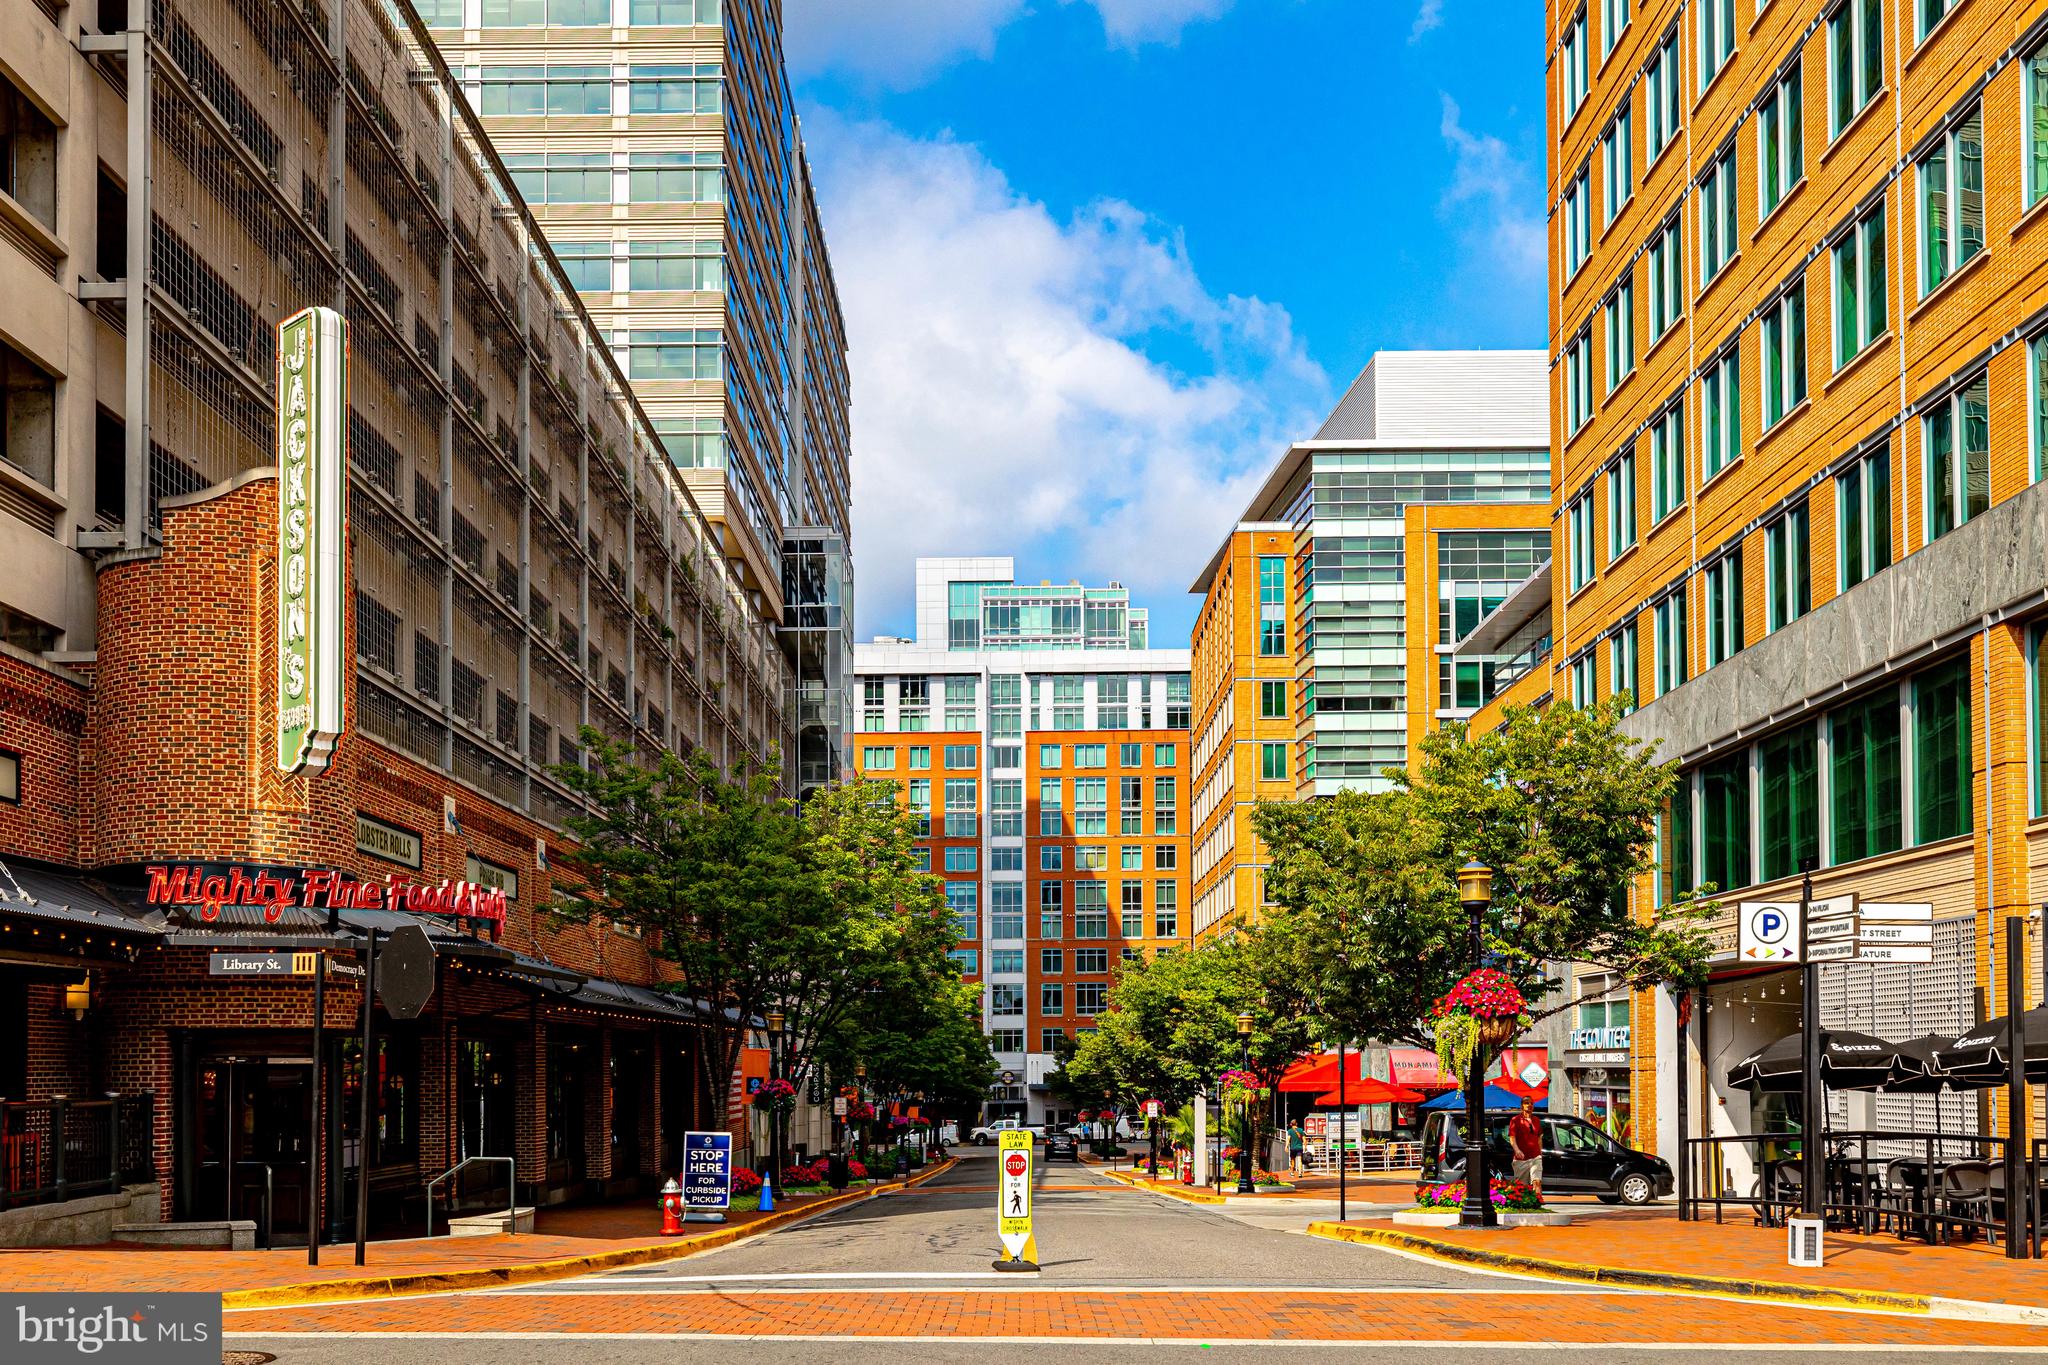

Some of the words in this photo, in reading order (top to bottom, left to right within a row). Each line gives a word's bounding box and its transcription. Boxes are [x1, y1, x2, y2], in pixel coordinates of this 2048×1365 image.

[284, 328, 306, 699] JACKSON'S
[357, 822, 388, 851] LOBSTER
[390, 834, 411, 860] ROLLS
[146, 866, 296, 924] Mighty
[302, 870, 383, 909] Fine
[386, 874, 454, 913] Food
[455, 880, 471, 917] &
[1763, 914, 1780, 937] P
[222, 959, 264, 973] Library
[266, 958, 282, 970] St.
[331, 960, 358, 978] Democracy
[358, 964, 366, 976] Dr.
[1569, 1028, 1586, 1050] THE
[1586, 1025, 1627, 1050] COUNTER
[1953, 1034, 1996, 1049] &pizza
[1830, 1042, 1882, 1052] &pizza
[690, 1150, 724, 1161] STOP
[690, 1162, 724, 1173] HERE
[1007, 1161, 1026, 1170] STOP
[698, 1177, 715, 1185] FOR
[685, 1186, 727, 1195] CURBSIDE
[692, 1196, 723, 1204] PICKUP
